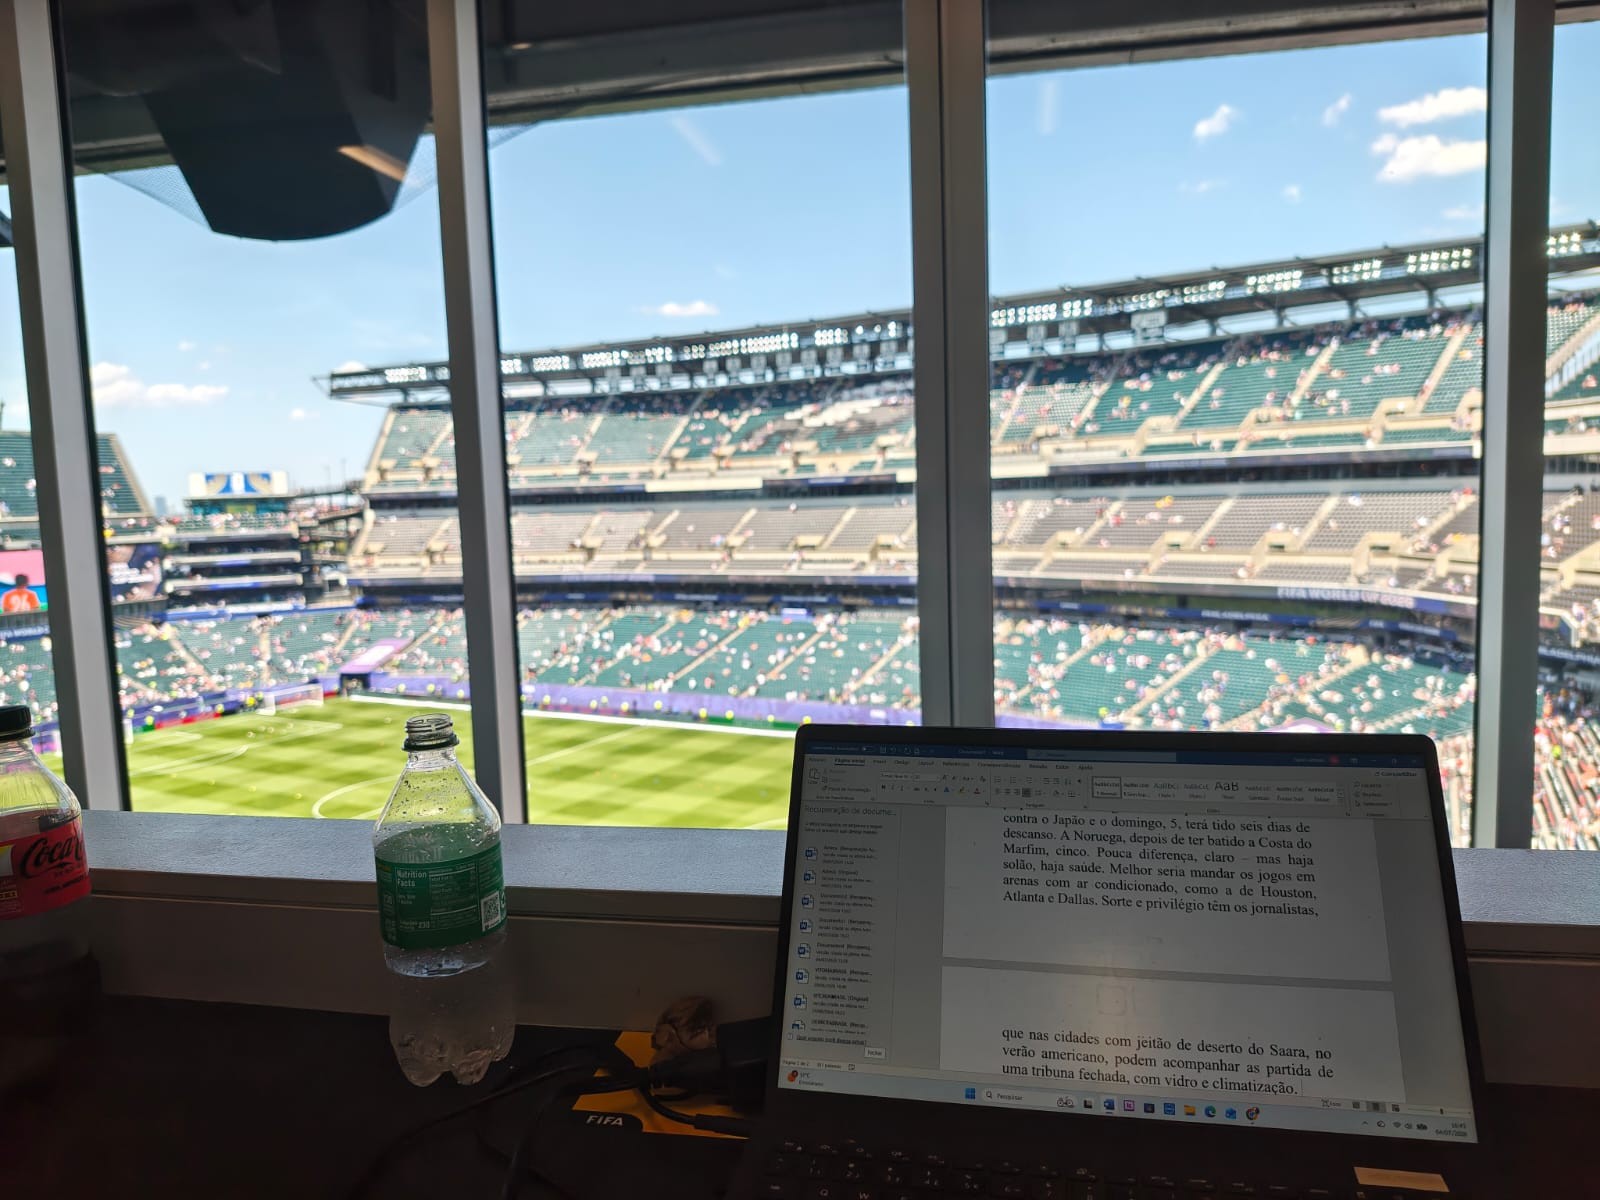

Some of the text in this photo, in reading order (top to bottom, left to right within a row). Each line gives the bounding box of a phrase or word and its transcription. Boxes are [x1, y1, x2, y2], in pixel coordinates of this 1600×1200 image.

[1277, 587, 1305, 599] FIFA
[1308, 588, 1360, 601] WORLD
[1002, 813, 1037, 824] contra
[1041, 816, 1049, 824] o
[1052, 814, 1087, 829] Japão
[1099, 818, 1107, 826] o
[1185, 818, 1208, 830] terá
[1211, 818, 1235, 830] tido
[1240, 820, 1263, 832] seis
[1266, 821, 1292, 832] dias
[1295, 821, 1310, 832] de
[1002, 827, 1312, 849] descanso. A Noruega, depois de ter batido a Costa do
[1003, 842, 1049, 858] Marfim,
[1055, 844, 1089, 856] cinco.
[1096, 846, 1132, 858] Pouca
[1138, 847, 1197, 864] diferença,
[1204, 850, 1235, 862] claro
[1256, 855, 1280, 864] mas
[1287, 853, 1314, 868] haja
[397, 870, 427, 879] Nutrition
[1002, 858, 1315, 883] solão, haja saúde. Melhor seria mandar os jogos em
[398, 879, 416, 887] Facts
[1002, 876, 1316, 900] arenas com ar condicionado, como a de Houston,
[1002, 889, 1318, 917] Atlanta e Dallas. Sorte e privilégio têm os jornalistas,
[1001, 1029, 1331, 1060] que nas cidades com jeitão de deserto do Saara, no
[1002, 1045, 1333, 1078] verão americano, podem acompanhar as partida de
[1002, 1064, 1298, 1098] uma tribuna fechada, com vidro e climatização.
[586, 1115, 623, 1126] FIFA
